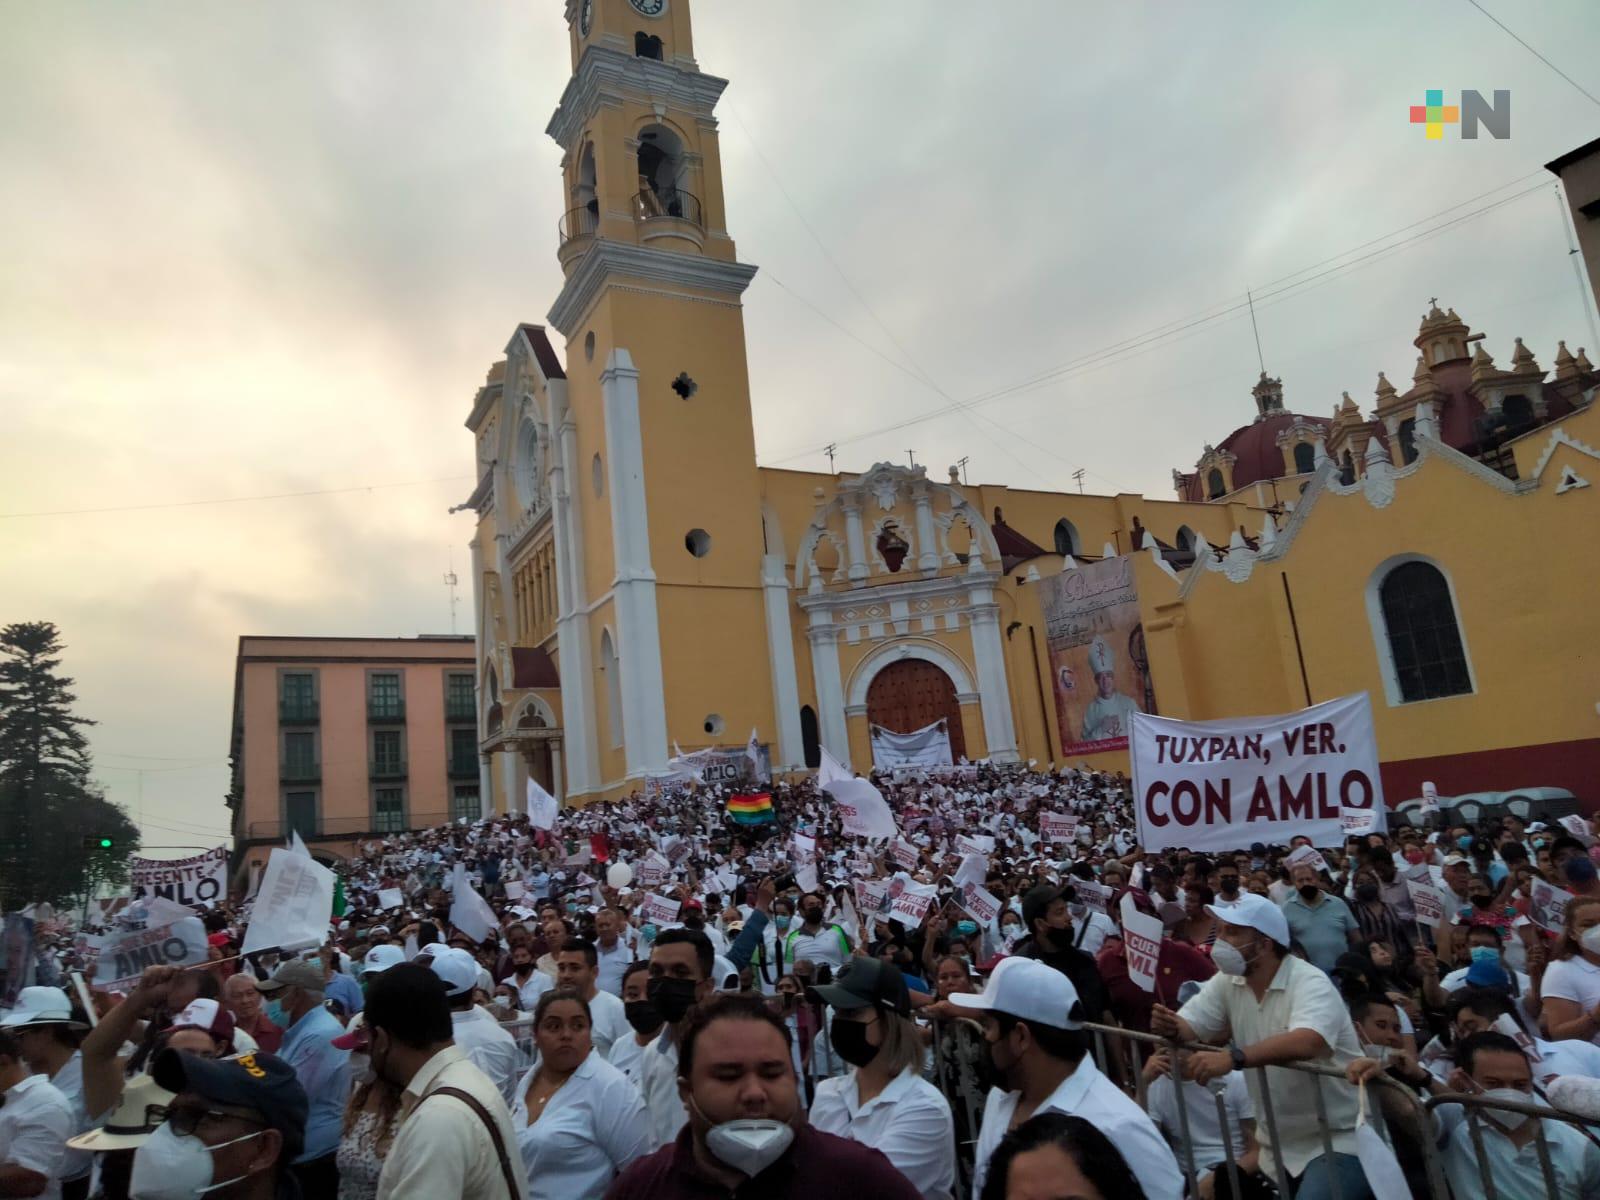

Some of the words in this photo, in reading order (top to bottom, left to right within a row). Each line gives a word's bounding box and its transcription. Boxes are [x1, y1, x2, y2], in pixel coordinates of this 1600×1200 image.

[1155, 733, 1272, 765] TUXPAN,
[1282, 722, 1346, 757] VER.
[1145, 778, 1232, 827] CON
[1246, 769, 1374, 823] AMLO
[131, 866, 206, 886] PRESENTE
[134, 877, 220, 906] AMLO
[114, 937, 189, 980] AMLO
